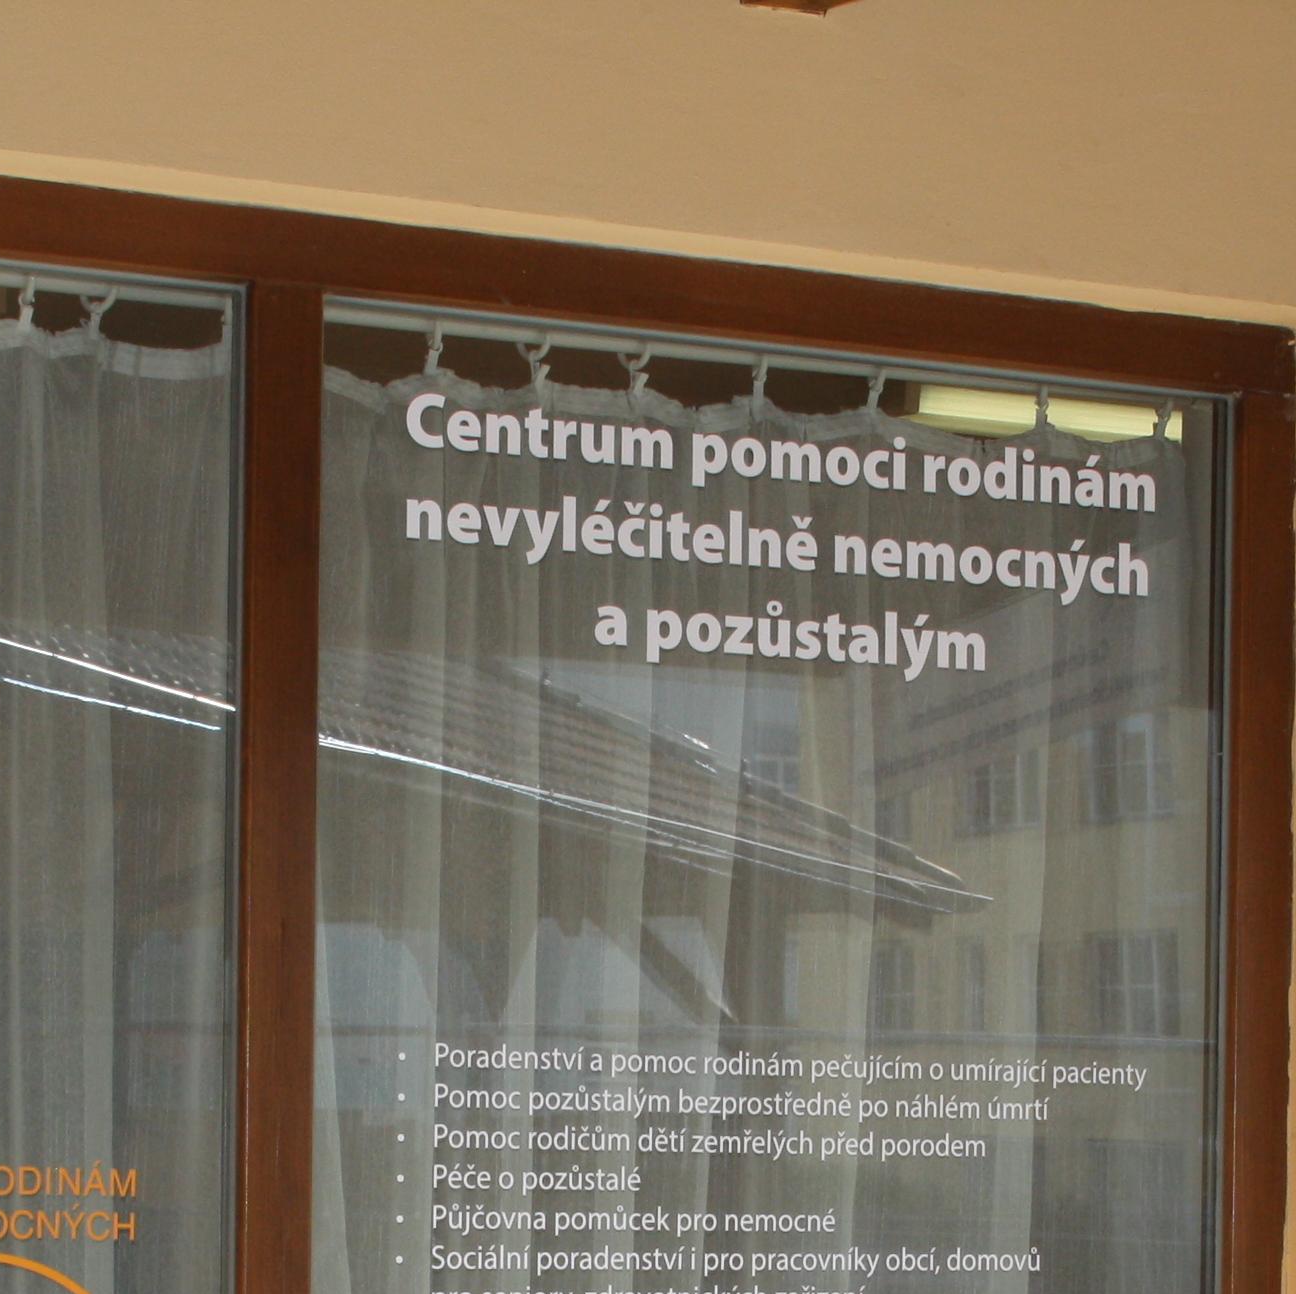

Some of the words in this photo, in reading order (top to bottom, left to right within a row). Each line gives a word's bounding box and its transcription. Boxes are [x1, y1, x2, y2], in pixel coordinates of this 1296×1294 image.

[405, 394, 675, 470] Centrum
[691, 436, 907, 491] pomoci
[922, 446, 1157, 512] rodinám
[405, 494, 818, 575] nevyléčitelně
[833, 532, 1150, 605] nemocných
[594, 604, 628, 647] a
[645, 600, 987, 683] pozůstalým
[434, 1042, 584, 1072] Poradenství
[590, 1054, 604, 1072] a
[610, 1054, 696, 1078] pomoc
[703, 1050, 803, 1077] rodinám
[810, 1054, 923, 1085] pečujícím
[929, 1063, 944, 1081] o
[950, 1058, 1047, 1088] umírající
[1052, 1061, 1147, 1092] pacienty
[433, 1083, 521, 1110] Pomoc
[528, 1086, 671, 1119] pozůstalým
[678, 1088, 852, 1121] bezprostředně
[858, 1099, 889, 1124] po
[895, 1094, 980, 1121] náhlém
[987, 1096, 1051, 1121] úmrtí
[433, 1124, 521, 1150] Pomoc
[527, 1125, 630, 1152] rodičům
[637, 1127, 686, 1154] dětí
[691, 1129, 813, 1161] zemřelých
[820, 1131, 874, 1161] před
[880, 1132, 987, 1162] porodem
[432, 1164, 492, 1191] Péče
[498, 1174, 515, 1191] o
[522, 1165, 642, 1196] pozůstalé
[432, 1203, 547, 1238] Půjčovna
[554, 1206, 671, 1236] pomůcek
[676, 1211, 718, 1237] pro
[724, 1208, 836, 1233] nemocné
[431, 1245, 530, 1271] Sociální
[536, 1247, 685, 1276] poradenství
[690, 1248, 696, 1271] i
[703, 1252, 744, 1277] pro
[751, 1247, 879, 1278] pracovníky
[885, 1247, 941, 1275] obcí,
[946, 1247, 1042, 1272] domovů
